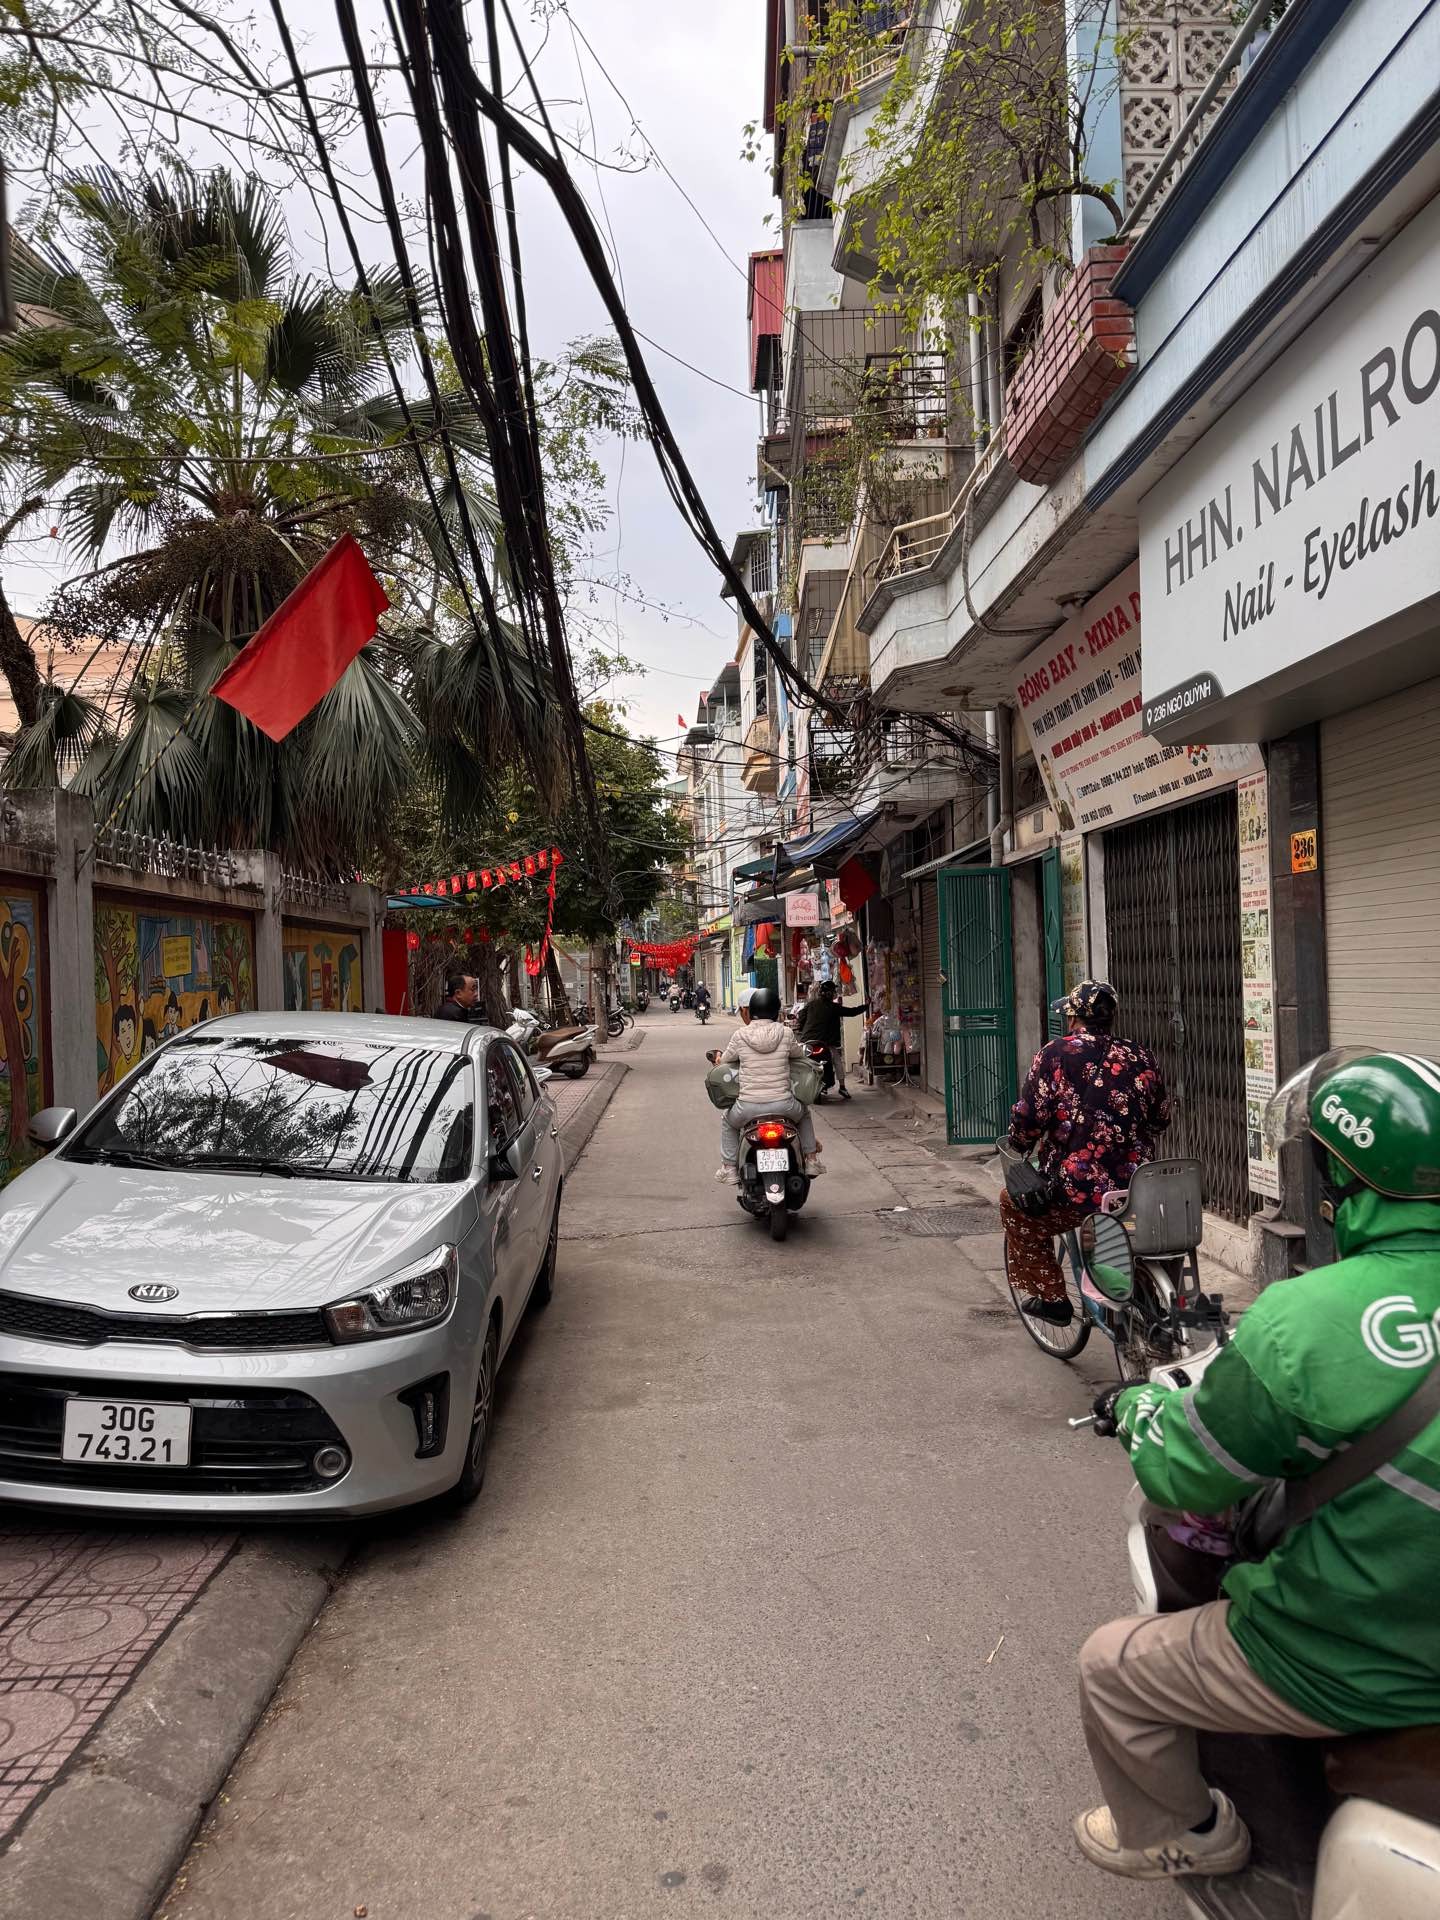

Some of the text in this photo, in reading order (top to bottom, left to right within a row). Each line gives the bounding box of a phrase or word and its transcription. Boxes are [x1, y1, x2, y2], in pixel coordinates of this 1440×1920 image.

[1164, 484, 1244, 595] HHN.
[1223, 459, 1440, 642] Nail - Eyelash
[1047, 644, 1078, 685] BAY
[1084, 604, 1132, 657] MINA
[1153, 702, 1166, 723] 236
[1167, 691, 1183, 716] NGÔ
[1293, 836, 1315, 860] 236
[1321, 1094, 1375, 1149] Grab
[136, 1284, 170, 1298] KIA
[100, 1405, 156, 1432] 30G
[77, 1433, 173, 1463] 743.21
